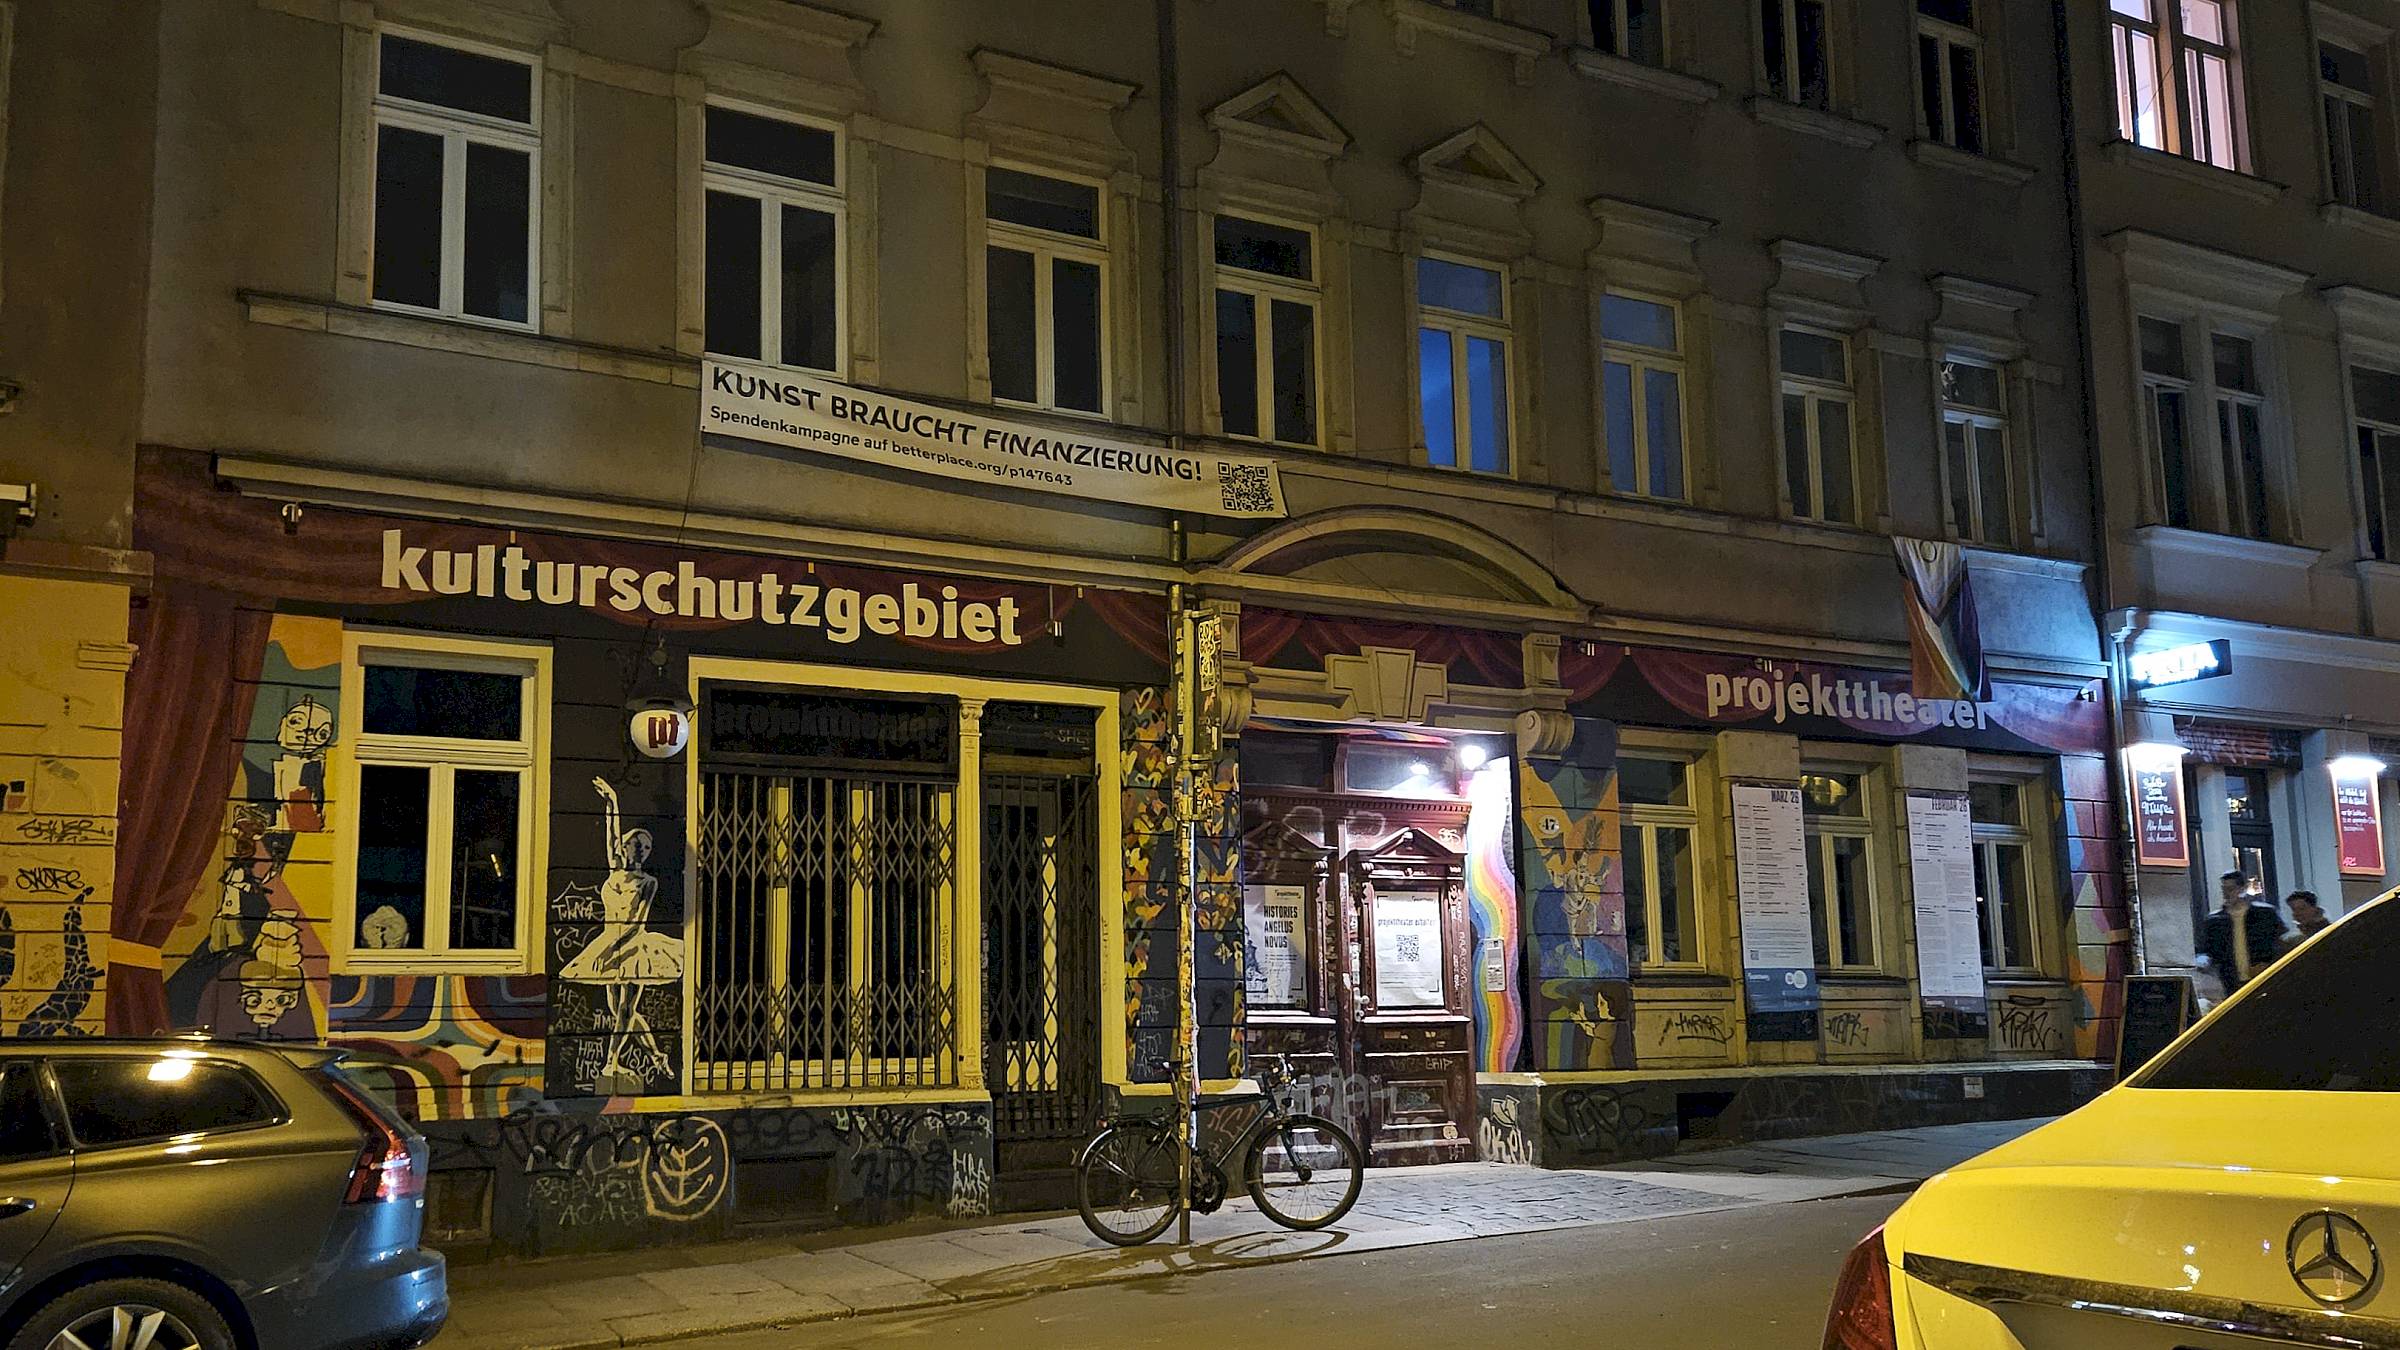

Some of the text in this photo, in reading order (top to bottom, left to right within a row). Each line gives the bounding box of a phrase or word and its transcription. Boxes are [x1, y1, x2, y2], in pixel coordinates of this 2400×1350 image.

[710, 406, 1073, 487] Spendenkampagne auf betterplace.org/p147643
[712, 367, 1203, 482] KUNST BRAUCHT FINANZIERUNG!
[381, 529, 1022, 645] kulturschutzgebiet
[1705, 669, 1989, 730] projekttheater
[648, 714, 680, 749] pt
[1264, 920, 1294, 933] ANGELUS
[1264, 935, 1288, 948] NOVUS
